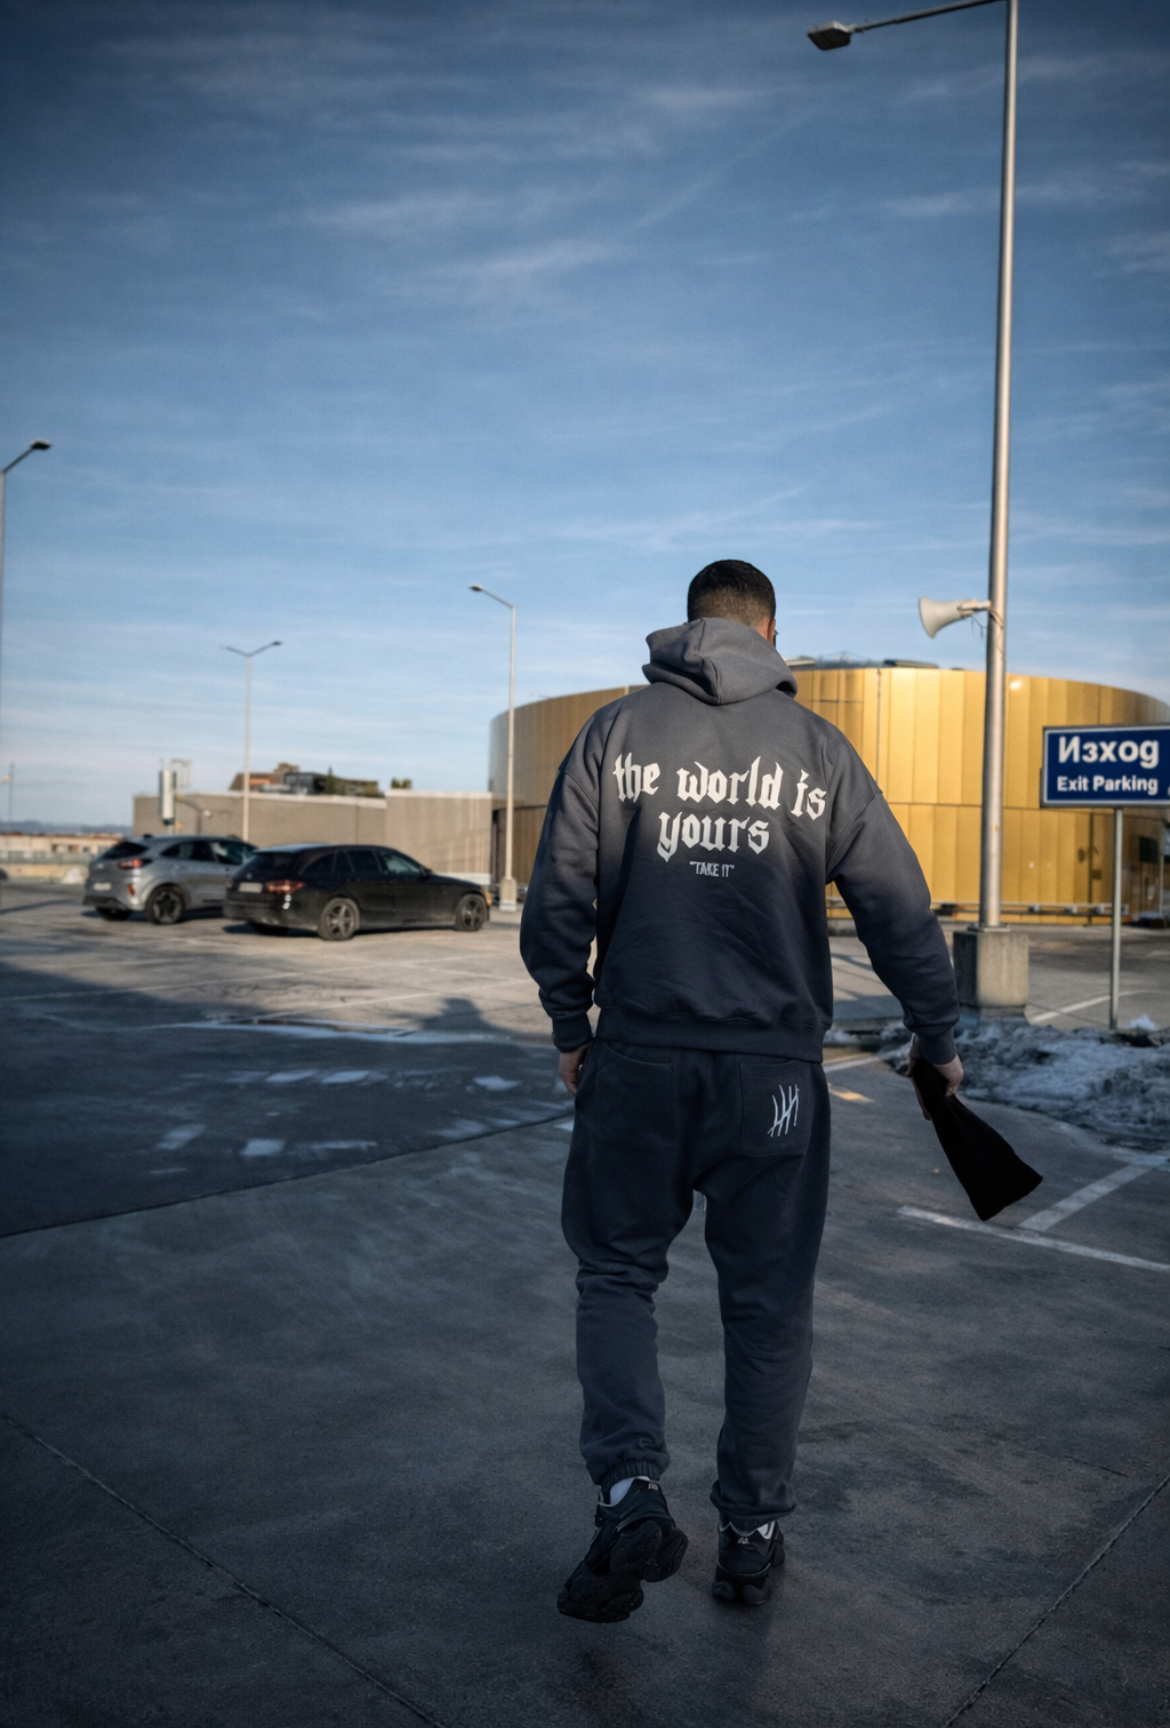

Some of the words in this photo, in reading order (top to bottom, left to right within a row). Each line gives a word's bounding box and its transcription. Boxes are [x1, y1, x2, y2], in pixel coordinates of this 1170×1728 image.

[612, 752, 661, 803] the
[676, 755, 784, 810] world
[791, 769, 827, 820] is
[1057, 775, 1089, 792] Exit
[1093, 774, 1159, 796] Parking
[656, 811, 770, 863] yours
